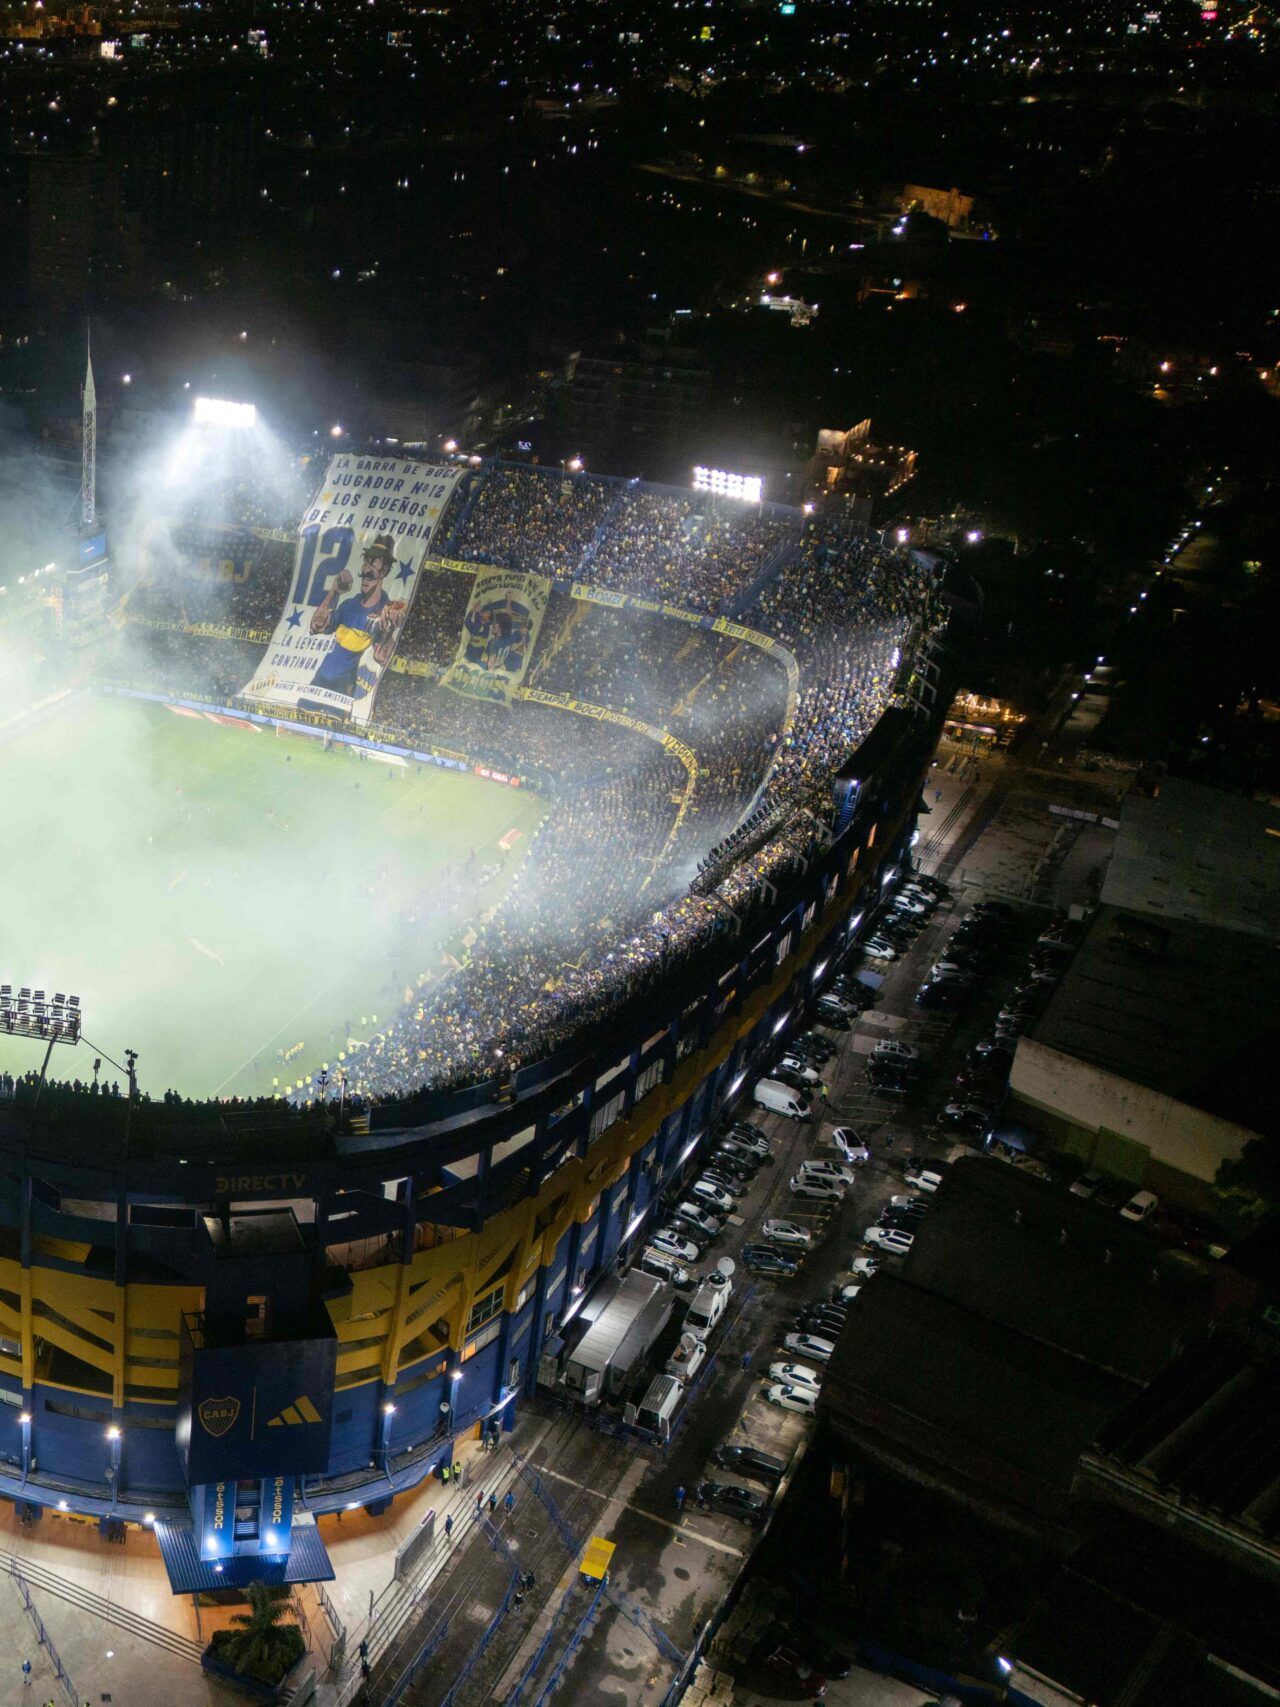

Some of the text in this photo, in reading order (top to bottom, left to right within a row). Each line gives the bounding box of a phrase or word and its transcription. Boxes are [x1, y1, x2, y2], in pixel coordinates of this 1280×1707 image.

[336, 458, 460, 480] LA BARRA DE BOCA
[332, 473, 406, 492] JUGADOR
[332, 492, 428, 517] LOS DUEÑOS
[308, 508, 432, 541] DE LA HISTORIA
[292, 523, 355, 608] 12
[271, 653, 319, 671] CONTINUA
[528, 689, 604, 718] SIEMPRE BOCA
[215, 1173, 307, 1194] DIRECTV
[203, 1408, 236, 1421] CABJ
[214, 1481, 226, 1530] etsson
[272, 1476, 285, 1525] etsson
